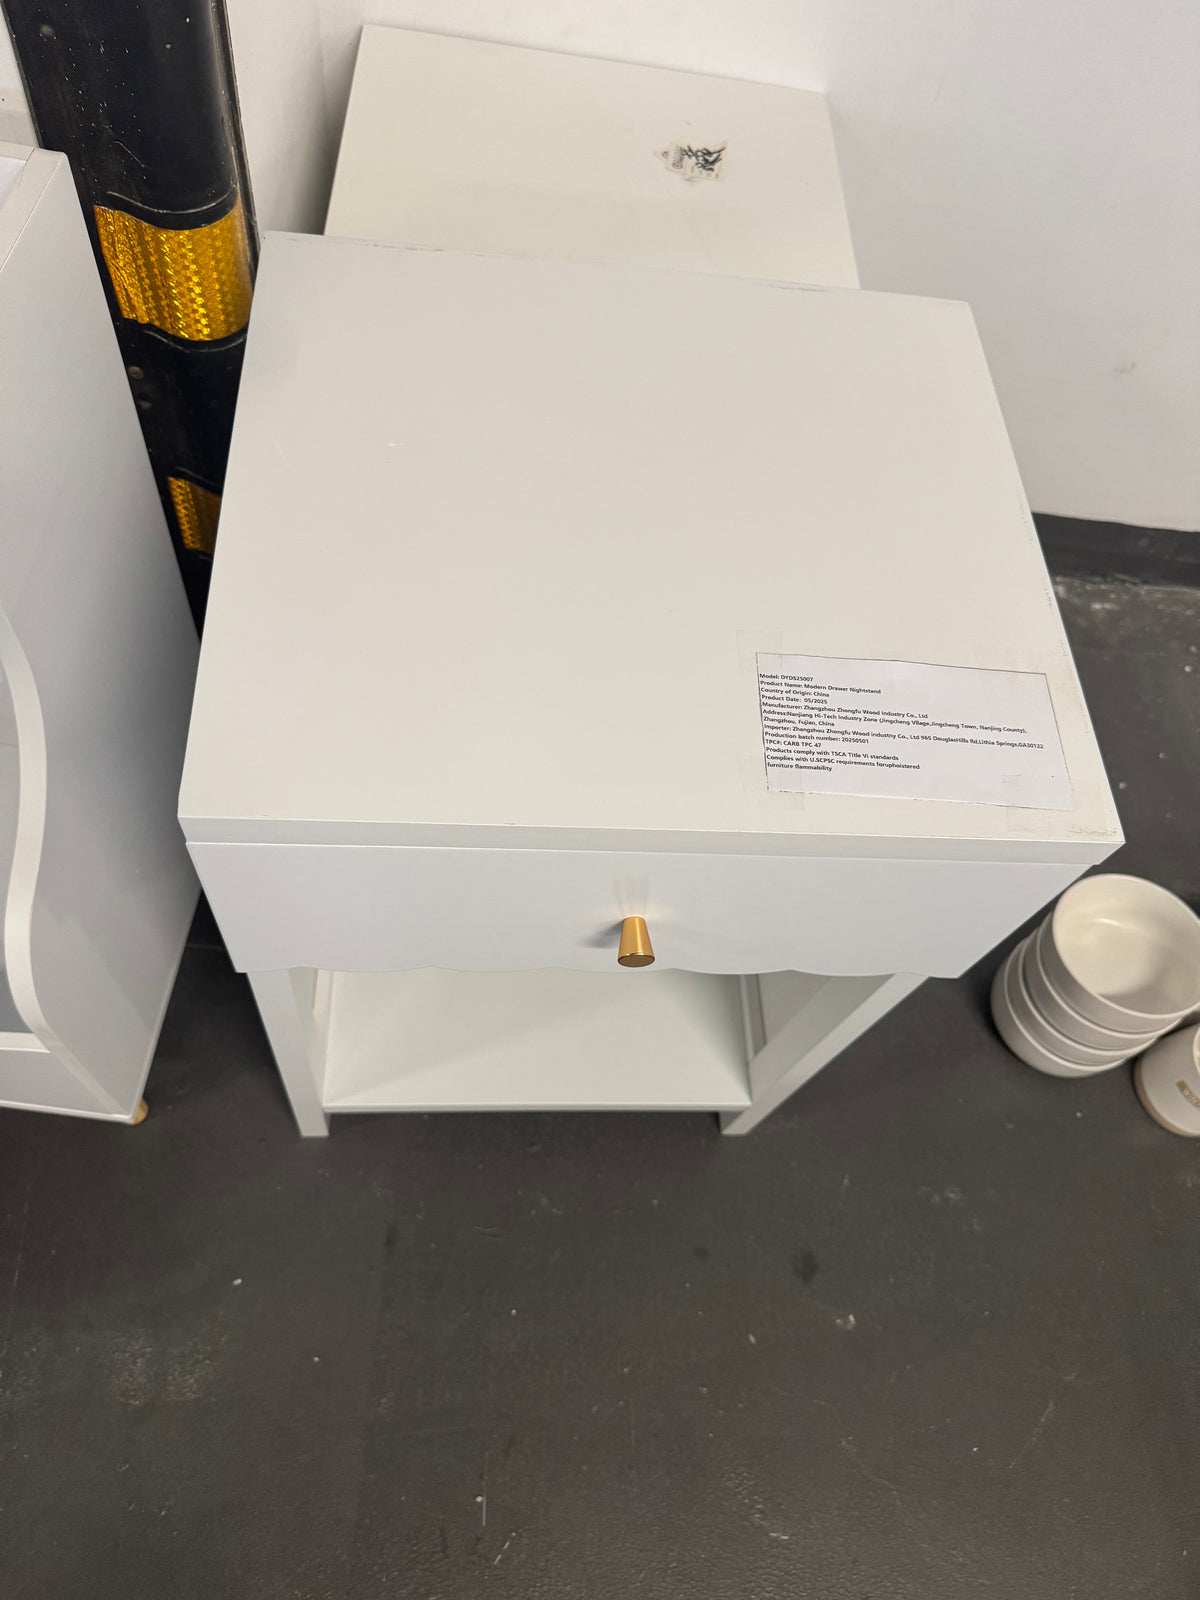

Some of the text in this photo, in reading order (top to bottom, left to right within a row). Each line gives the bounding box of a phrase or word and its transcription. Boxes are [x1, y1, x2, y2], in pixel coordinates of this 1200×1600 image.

[762, 701, 802, 709] Manufacturer:
[765, 731, 796, 739] Production
[795, 763, 832, 771] flammability
